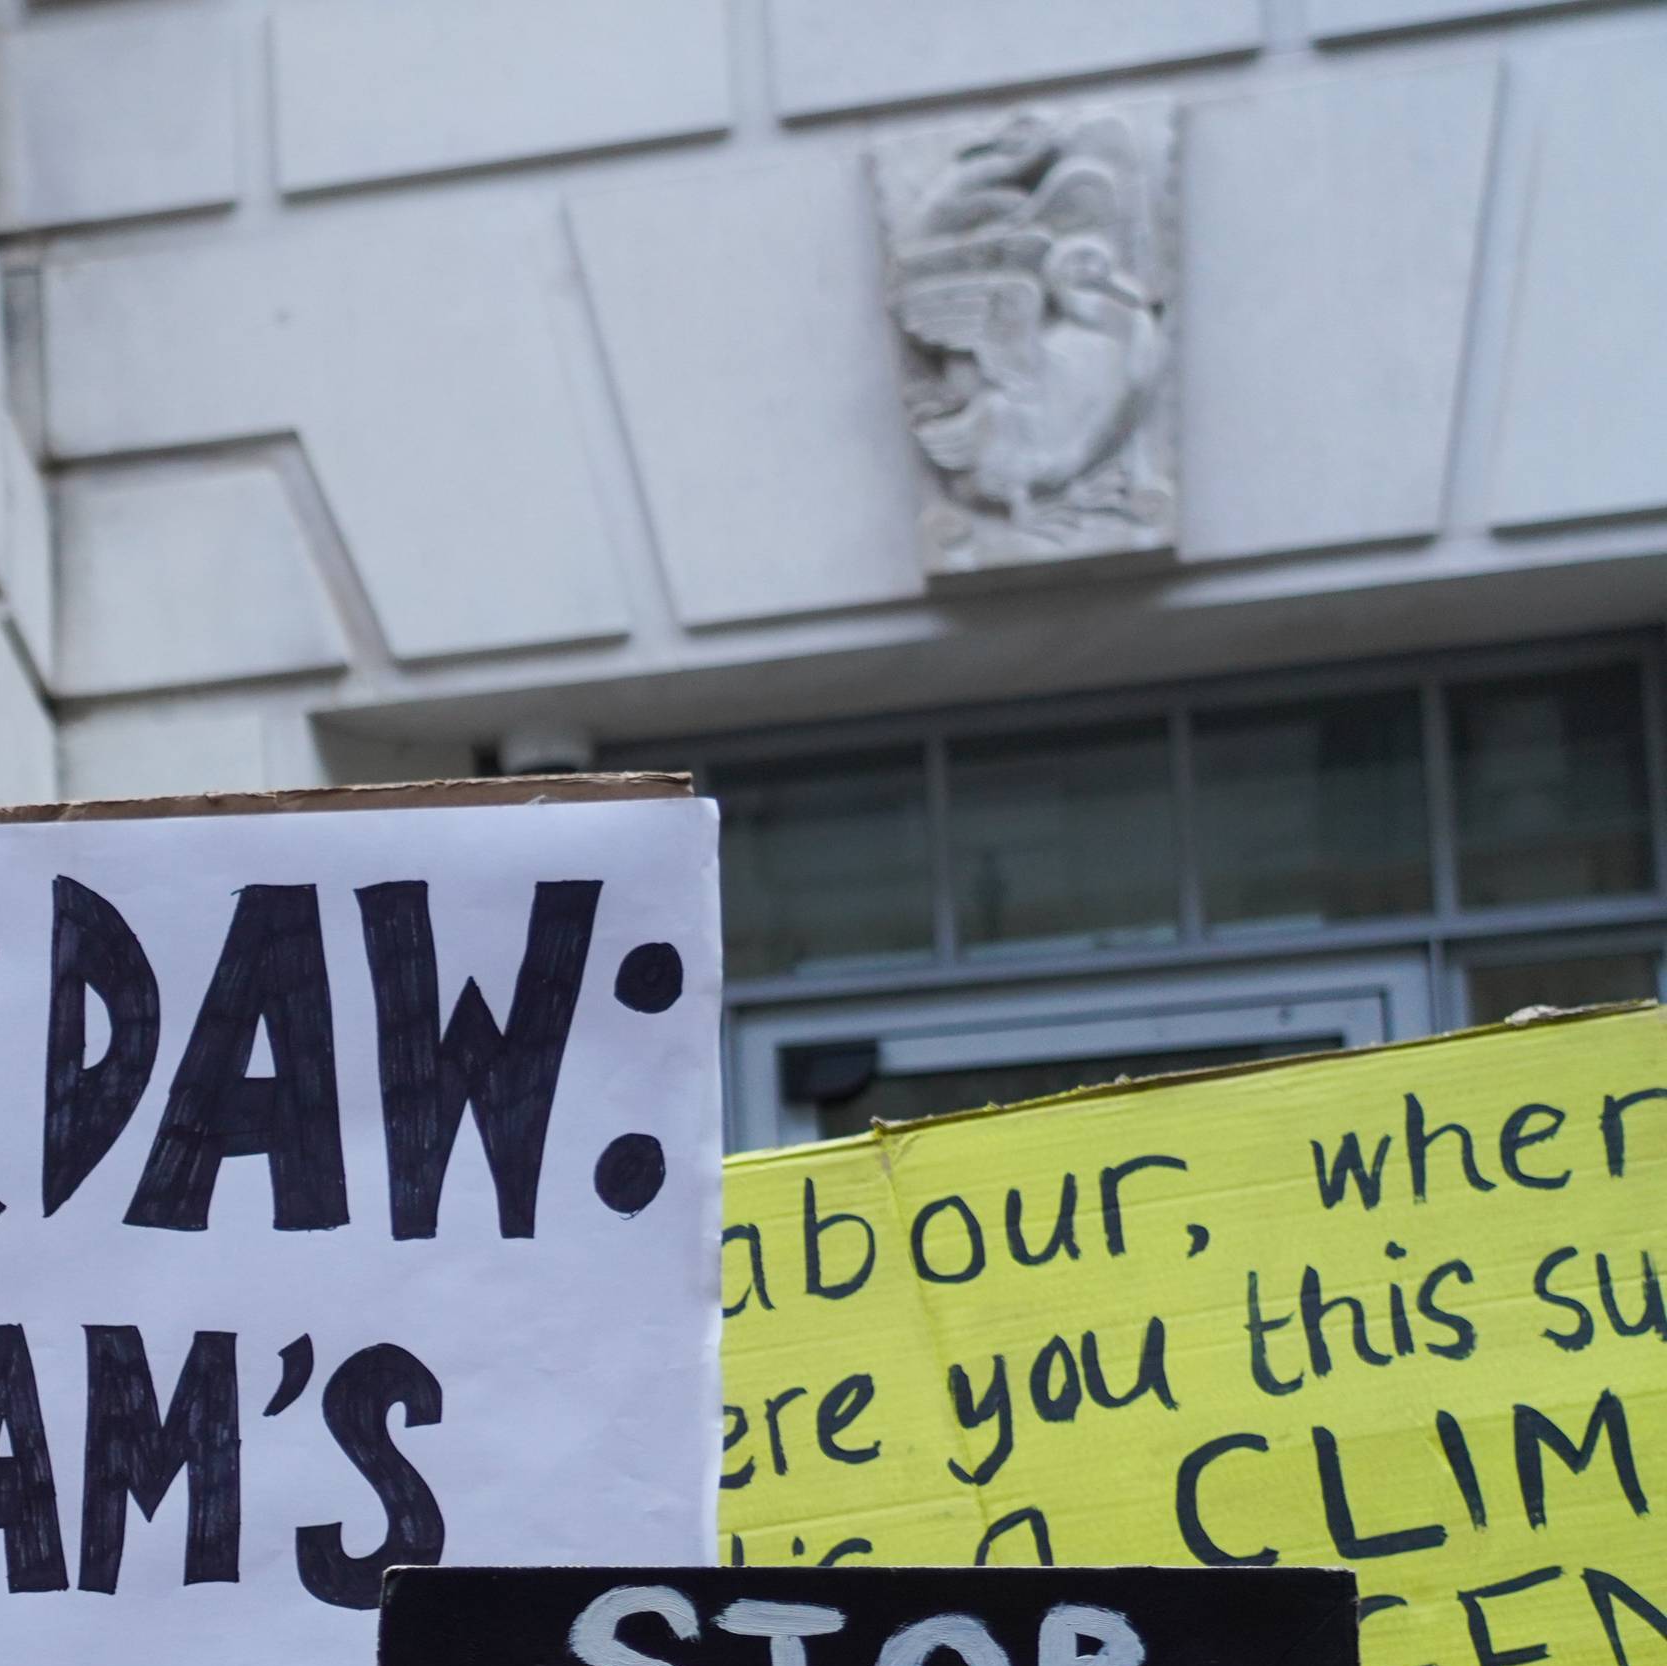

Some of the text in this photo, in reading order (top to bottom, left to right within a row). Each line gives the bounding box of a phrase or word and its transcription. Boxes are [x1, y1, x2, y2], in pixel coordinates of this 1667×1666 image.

[947, 1317, 1180, 1486] you
[1244, 1242, 1477, 1395] this
[1175, 1388, 1649, 1567] CLIM
